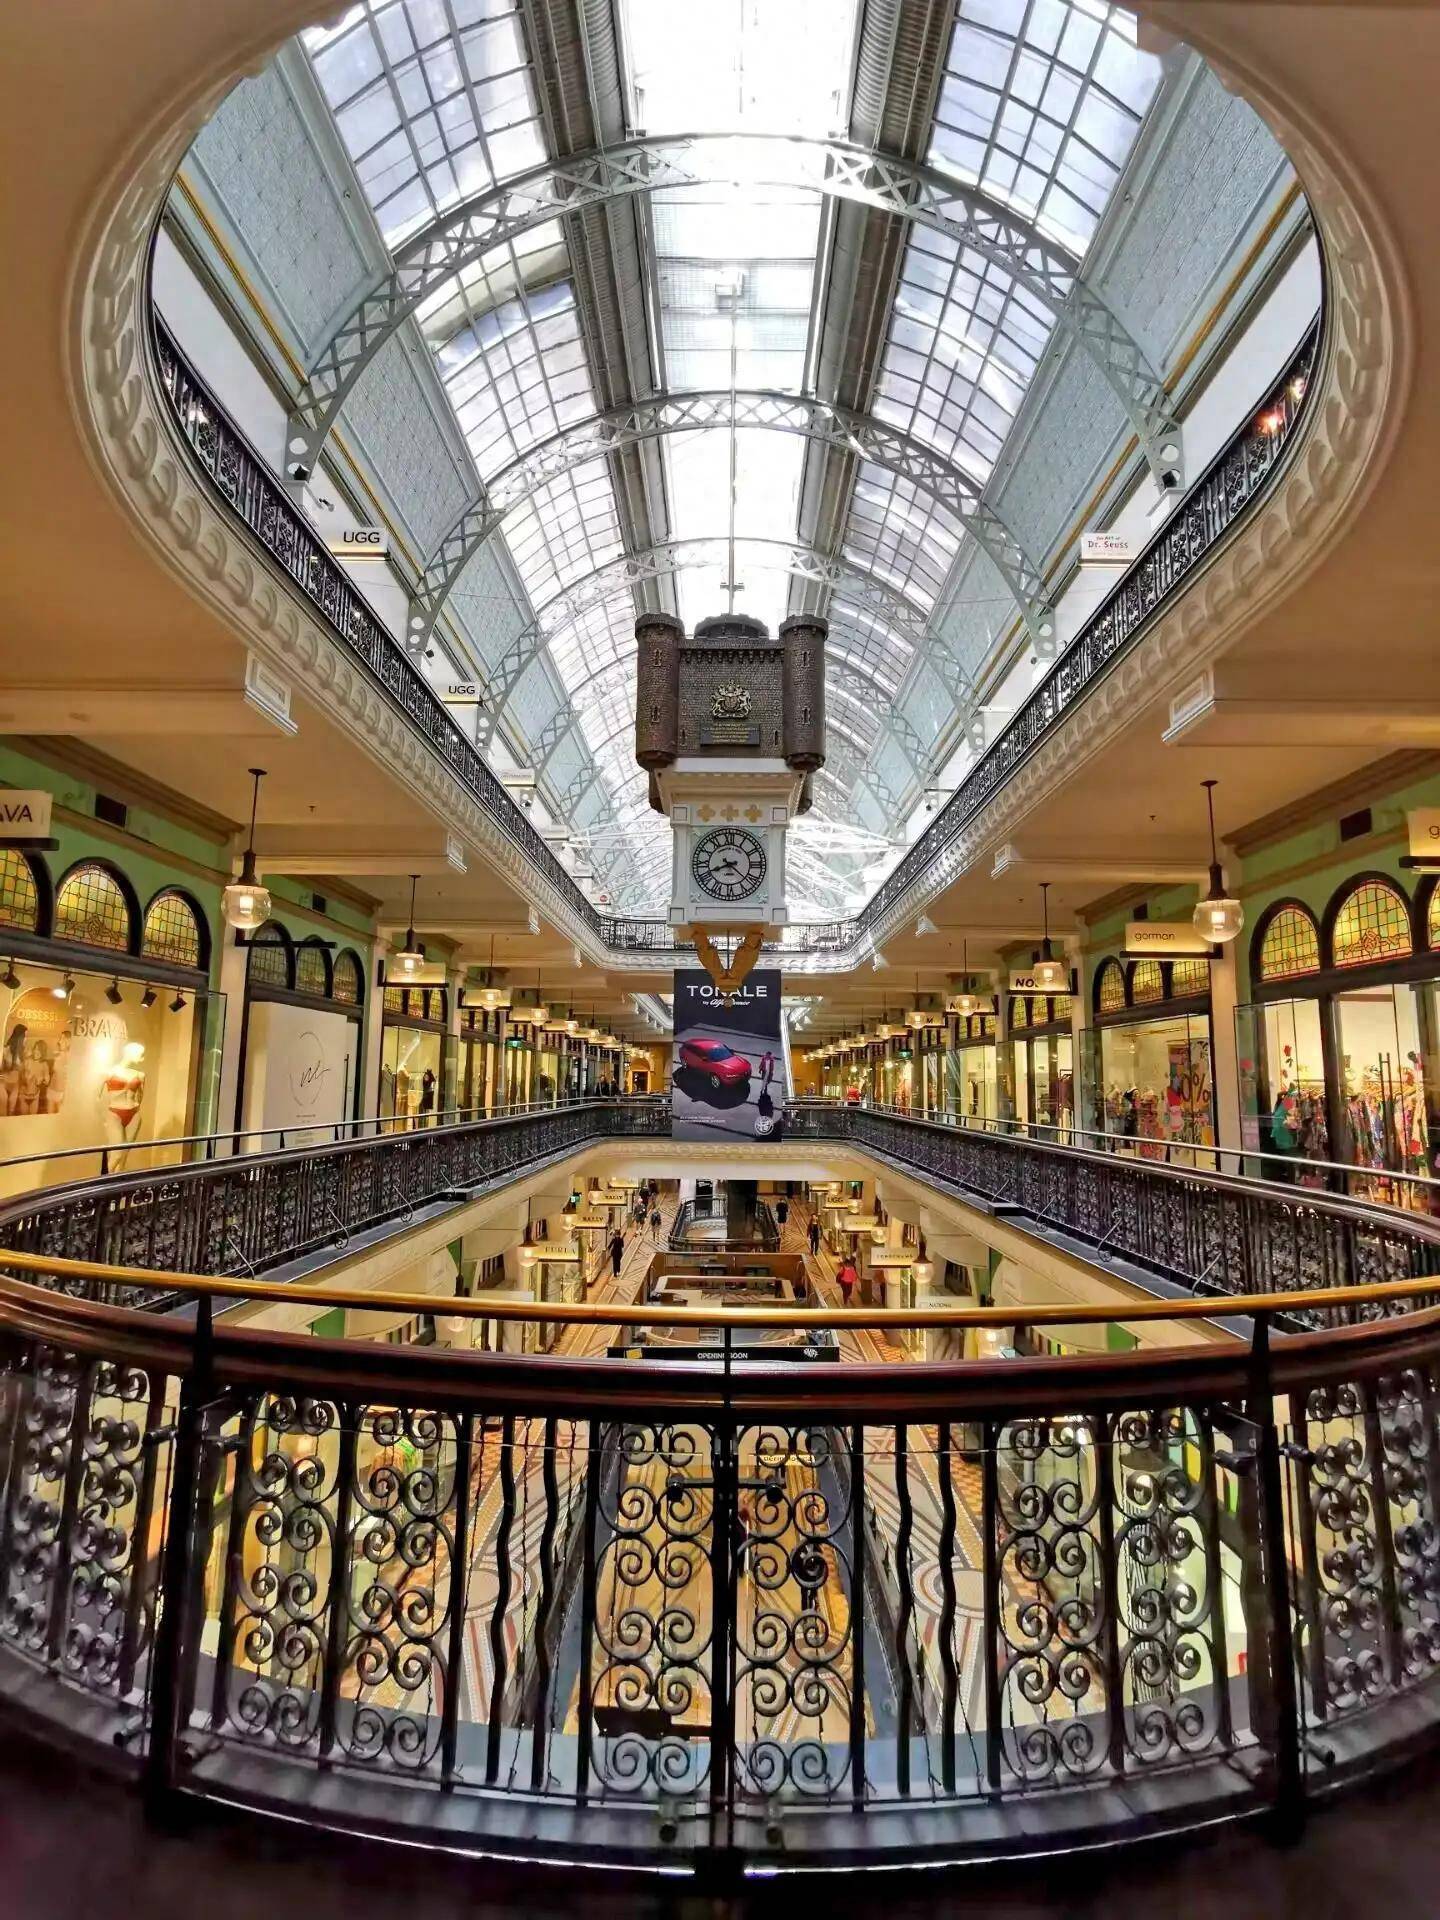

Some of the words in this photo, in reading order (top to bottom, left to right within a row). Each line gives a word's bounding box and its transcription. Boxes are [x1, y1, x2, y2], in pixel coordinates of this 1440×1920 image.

[343, 531, 380, 543] UGG
[1088, 540, 1101, 548] Dr.
[1104, 540, 1128, 549] Seuss
[448, 685, 476, 695] UGG
[1134, 932, 1176, 942] gorman
[697, 1352, 725, 1360] OPENIN
